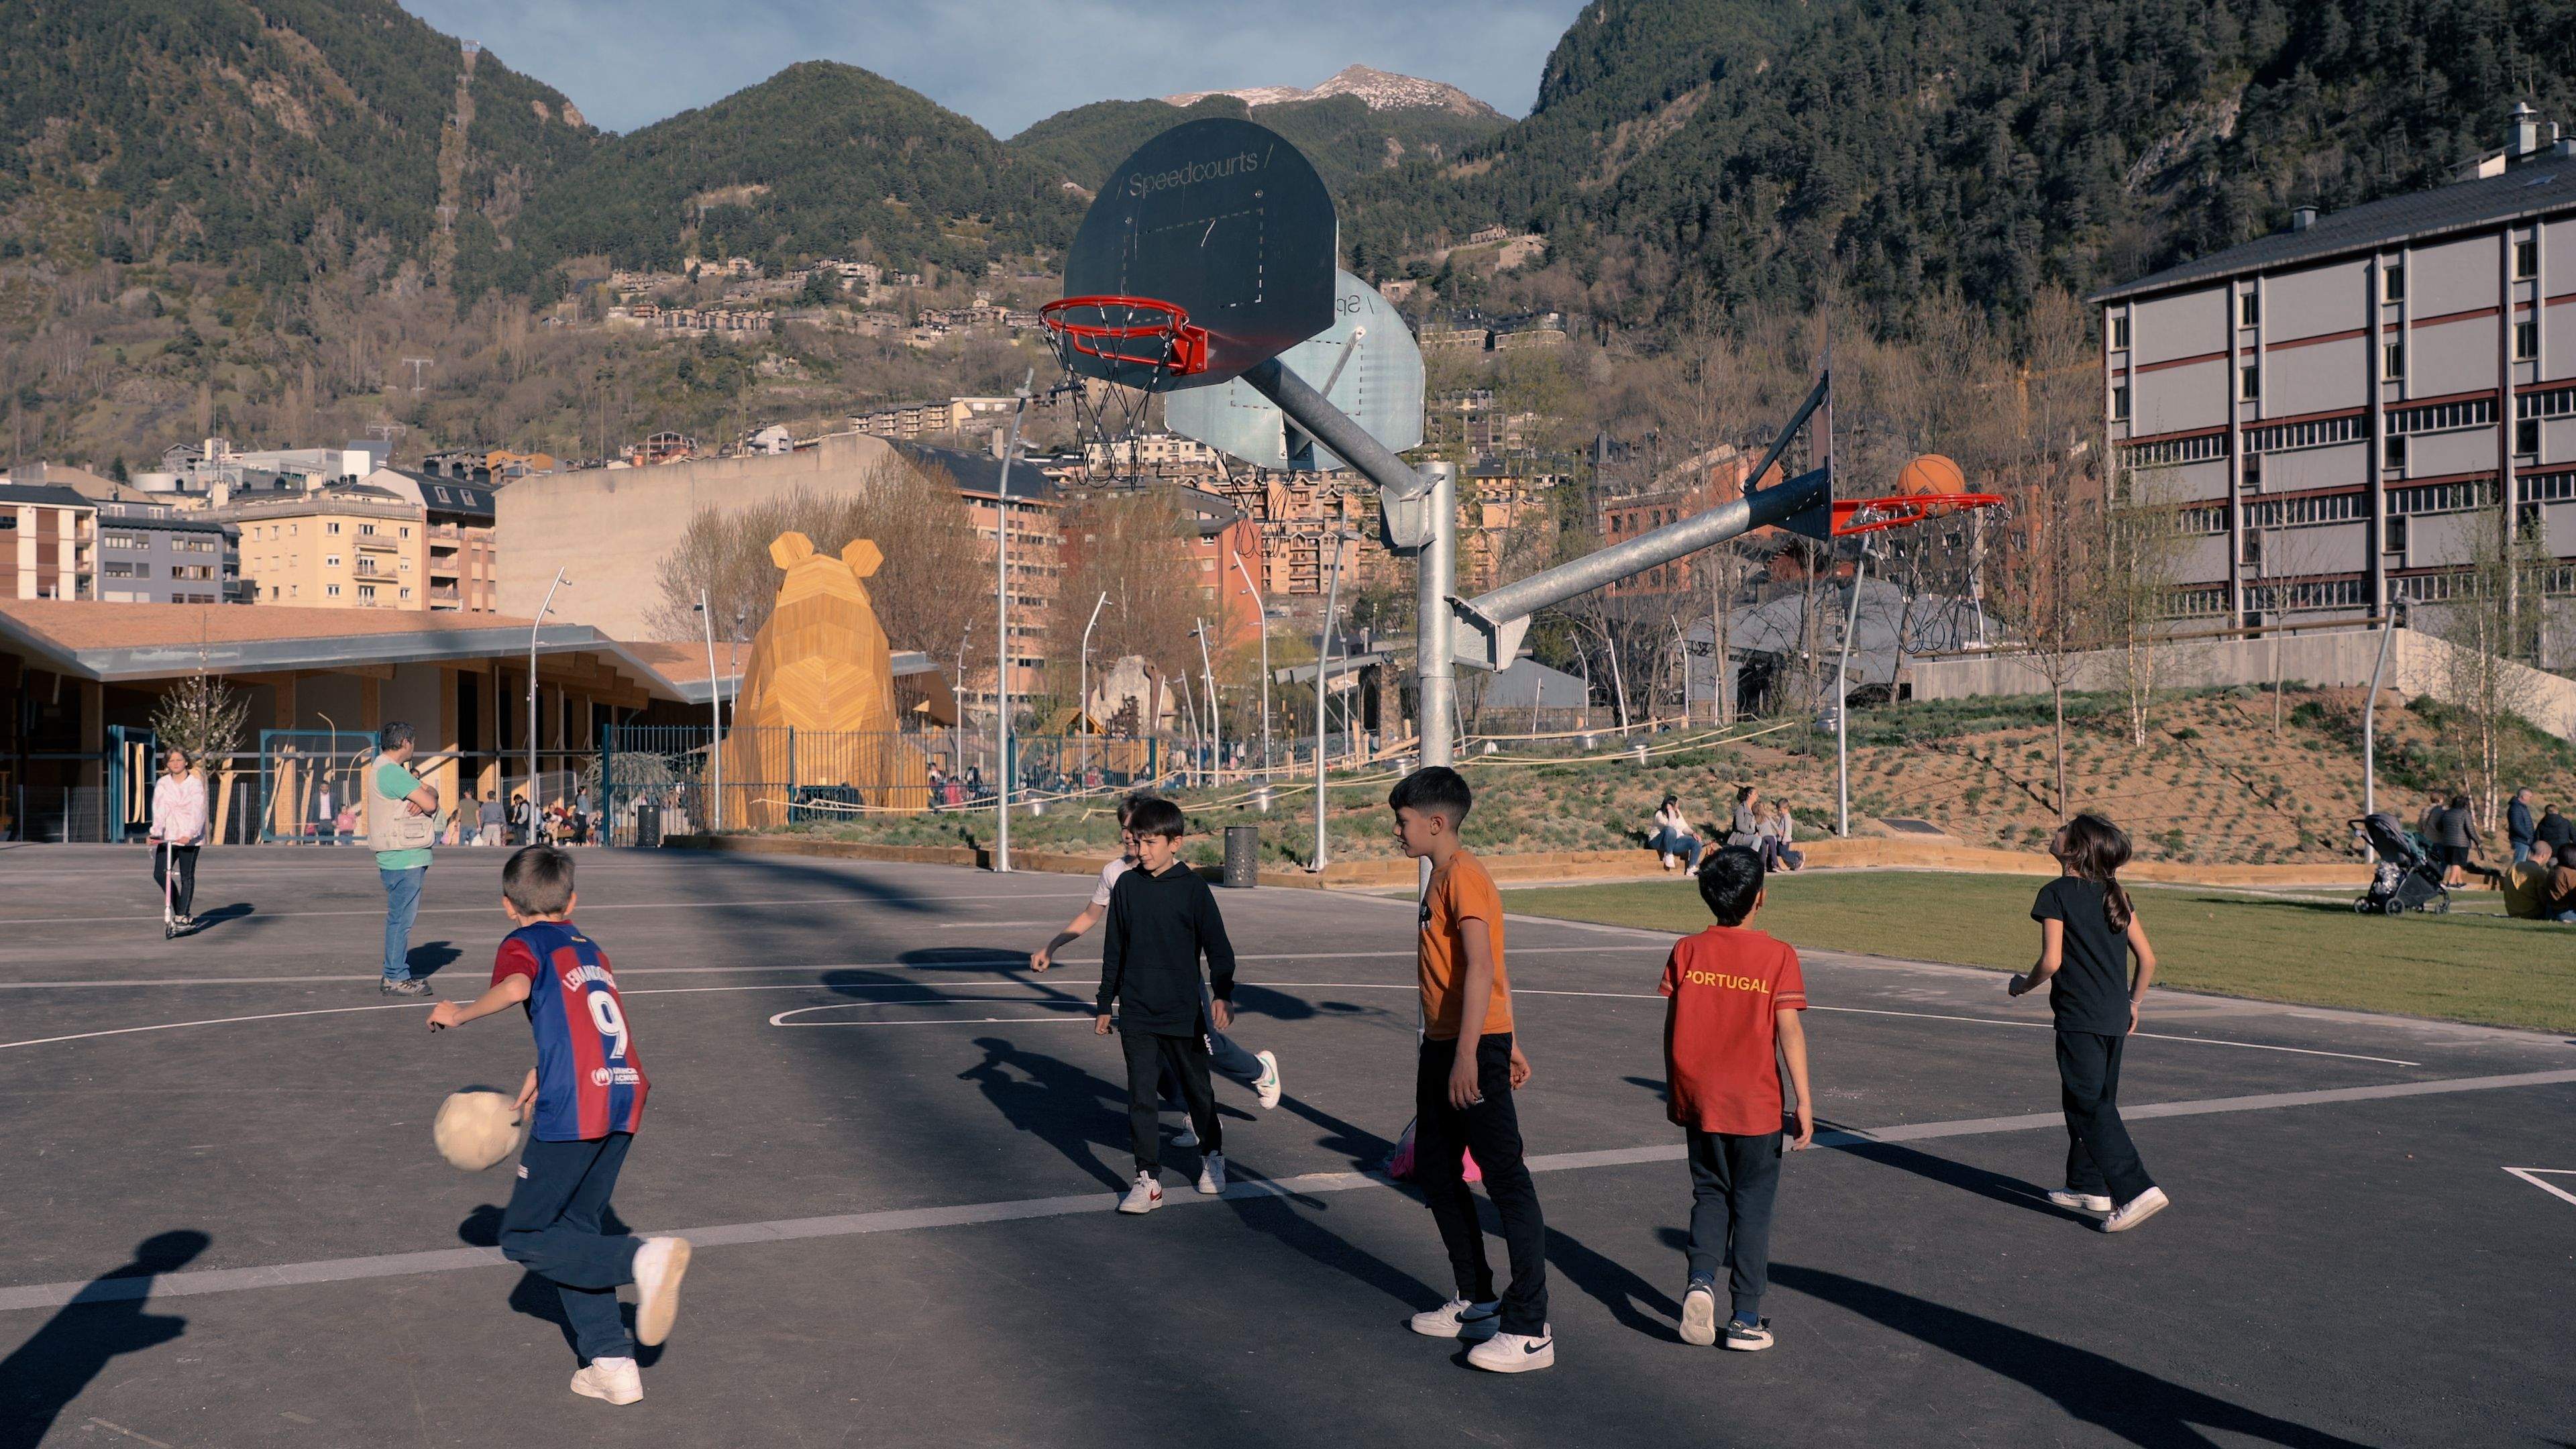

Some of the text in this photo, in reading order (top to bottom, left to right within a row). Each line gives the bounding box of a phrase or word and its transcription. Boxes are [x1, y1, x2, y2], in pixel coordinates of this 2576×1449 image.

[1129, 152, 1258, 199] Speedcourts
[1683, 970, 1770, 994] PORTUGAL
[587, 990, 628, 1059] 9
